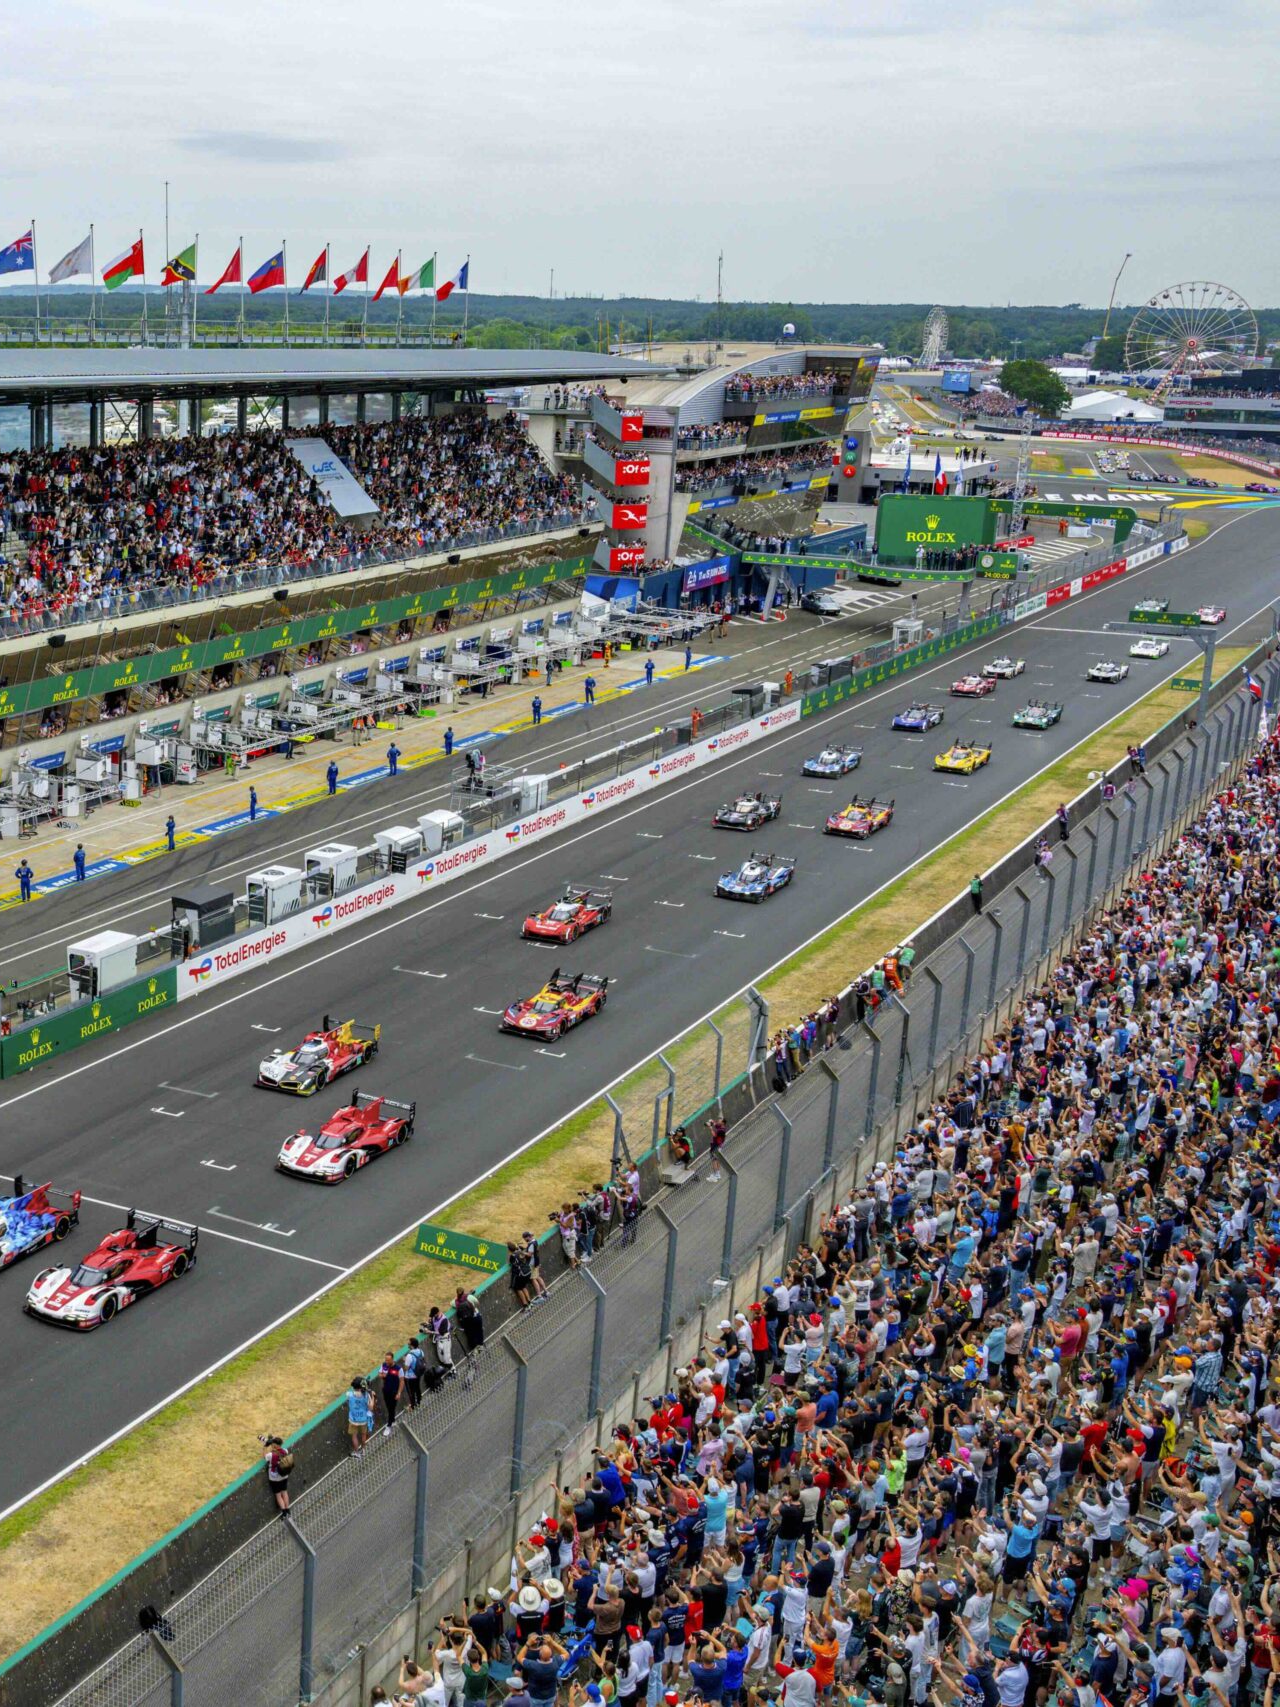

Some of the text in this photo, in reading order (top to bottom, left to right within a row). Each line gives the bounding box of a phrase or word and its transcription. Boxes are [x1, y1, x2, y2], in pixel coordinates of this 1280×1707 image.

[906, 532, 956, 543] ROLEX
[983, 572, 1010, 580] 24:00:00
[223, 649, 245, 660] ROLEX
[170, 661, 193, 673] ROLEX
[114, 674, 138, 687] ROLEX
[53, 688, 79, 702] ROLEX
[769, 707, 797, 727] TotalEnergies
[717, 729, 750, 749] TotalEnergies
[661, 751, 696, 775] TotalEnergies
[595, 778, 635, 805] TotalEnergies
[521, 808, 566, 837] TotalEnergies
[435, 843, 487, 876] TotalEnergies
[334, 883, 395, 920] TotalEnergies
[214, 930, 286, 973] TotalEnergies
[81, 1016, 112, 1038] ROLEX
[19, 1042, 53, 1065] ROLEX
[420, 1241, 500, 1272] ROLEX ROLEX
